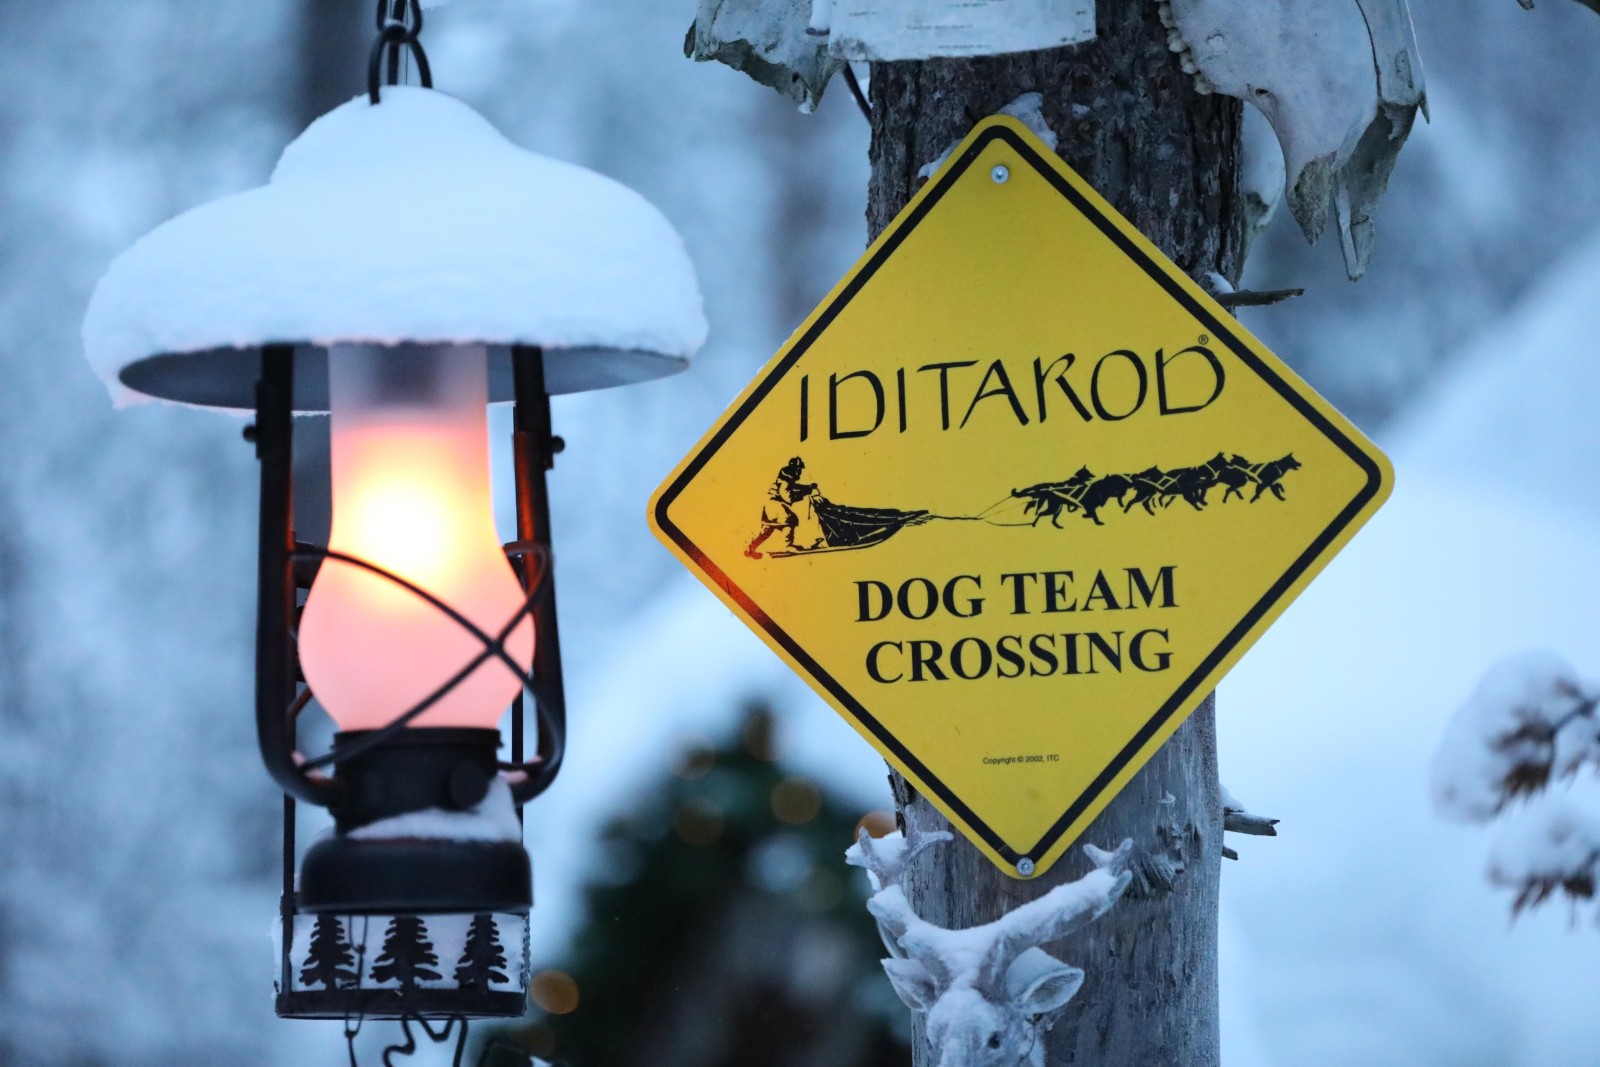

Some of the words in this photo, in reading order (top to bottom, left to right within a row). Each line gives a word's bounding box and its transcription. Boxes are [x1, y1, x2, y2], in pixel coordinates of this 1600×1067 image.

[853, 573, 986, 623] DOG
[1000, 565, 1179, 615] TEAM
[865, 628, 1174, 684] CROSSING
[982, 756, 1016, 765] Copyright
[1046, 754, 1060, 762] ITC
